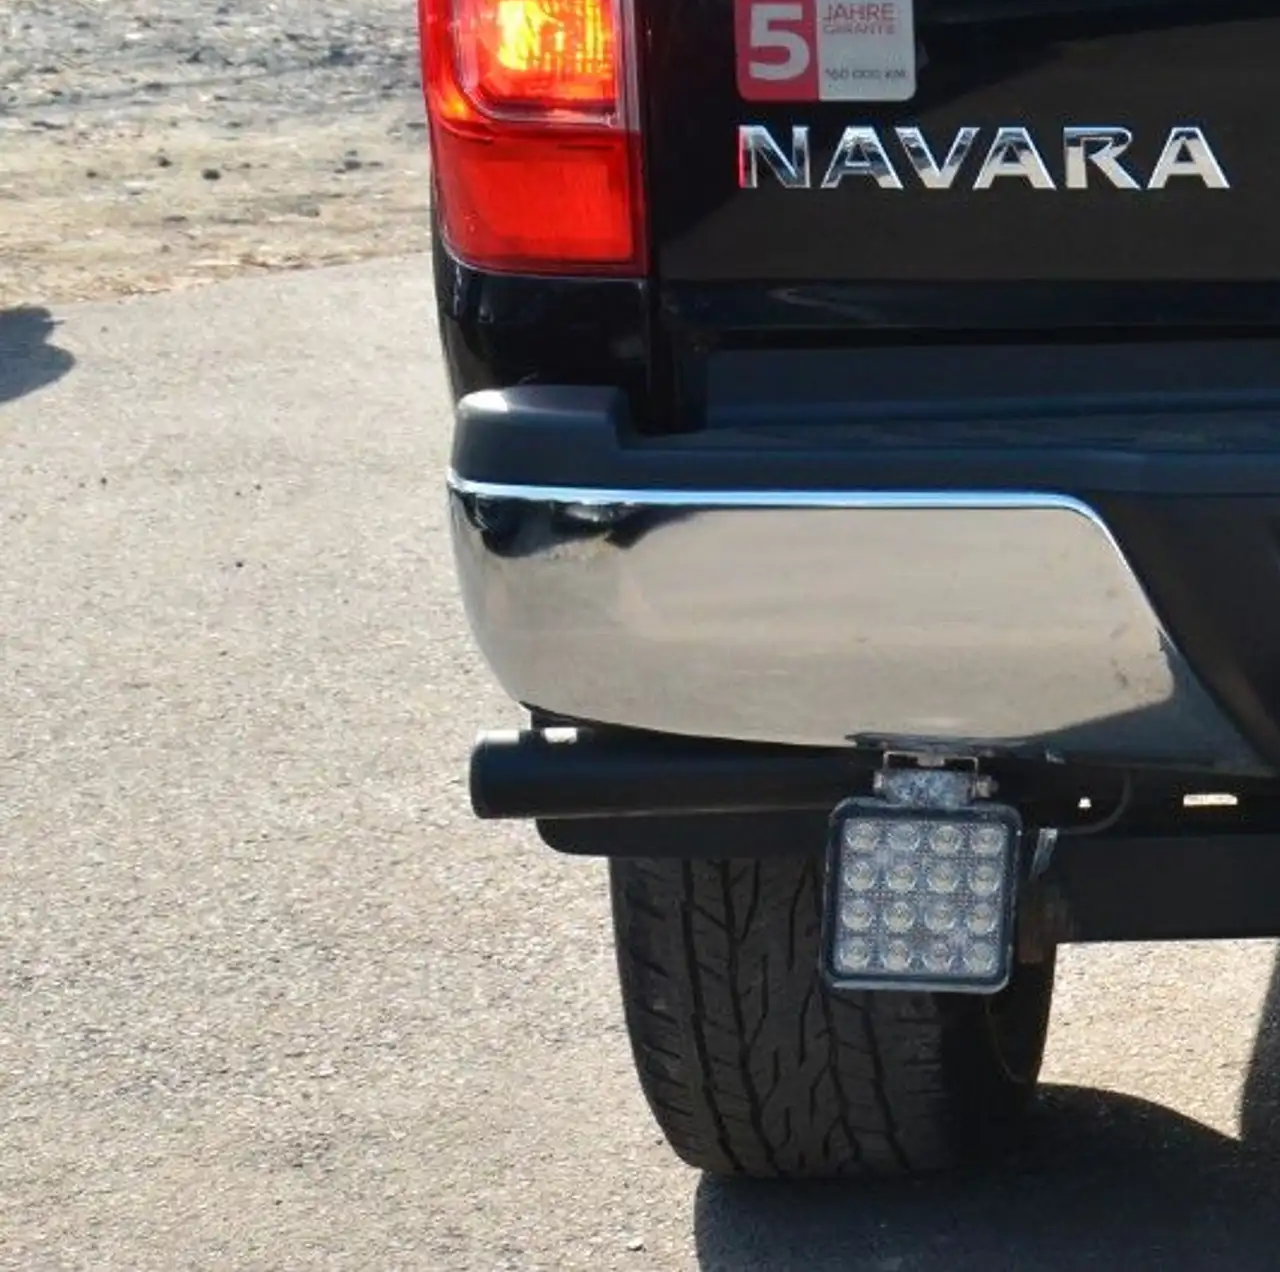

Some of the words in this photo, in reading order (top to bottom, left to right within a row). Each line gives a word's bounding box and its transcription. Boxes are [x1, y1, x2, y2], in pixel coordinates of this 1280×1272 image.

[749, 3, 810, 81] 5
[823, 2, 896, 22] JAHRE
[738, 124, 1230, 189] NAVARA
